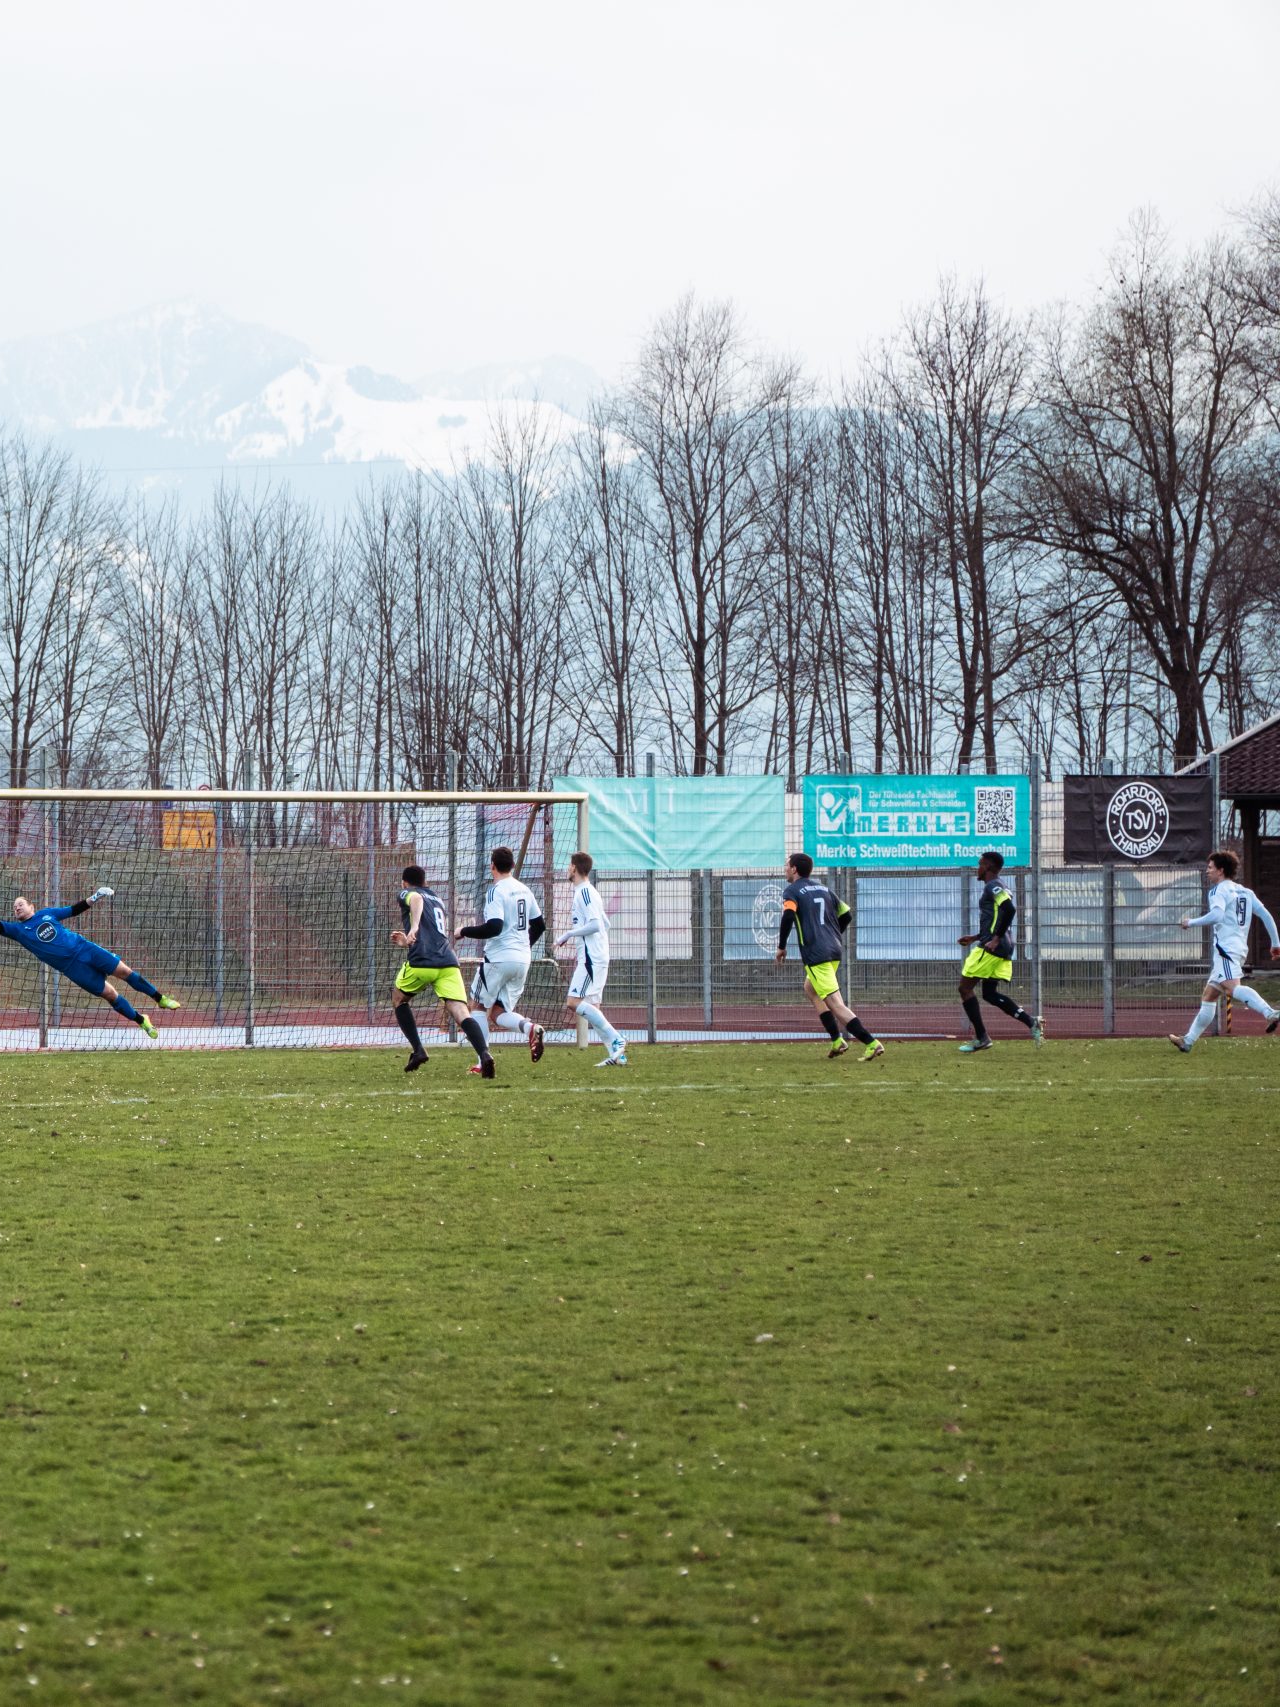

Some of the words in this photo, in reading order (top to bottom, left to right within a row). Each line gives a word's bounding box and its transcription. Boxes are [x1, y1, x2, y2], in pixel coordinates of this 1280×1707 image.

[922, 800, 928, 808] &
[1111, 786, 1166, 817] ROHRDORF
[856, 814, 967, 834] MERKLE
[1125, 809, 1151, 830] TSV
[816, 844, 857, 859] Merkle
[860, 844, 951, 858] Schweißtechnik
[954, 843, 1017, 858] Rosenheim
[1113, 830, 1161, 855] THANSAU
[433, 906, 447, 937] 8
[813, 897, 825, 925] 7
